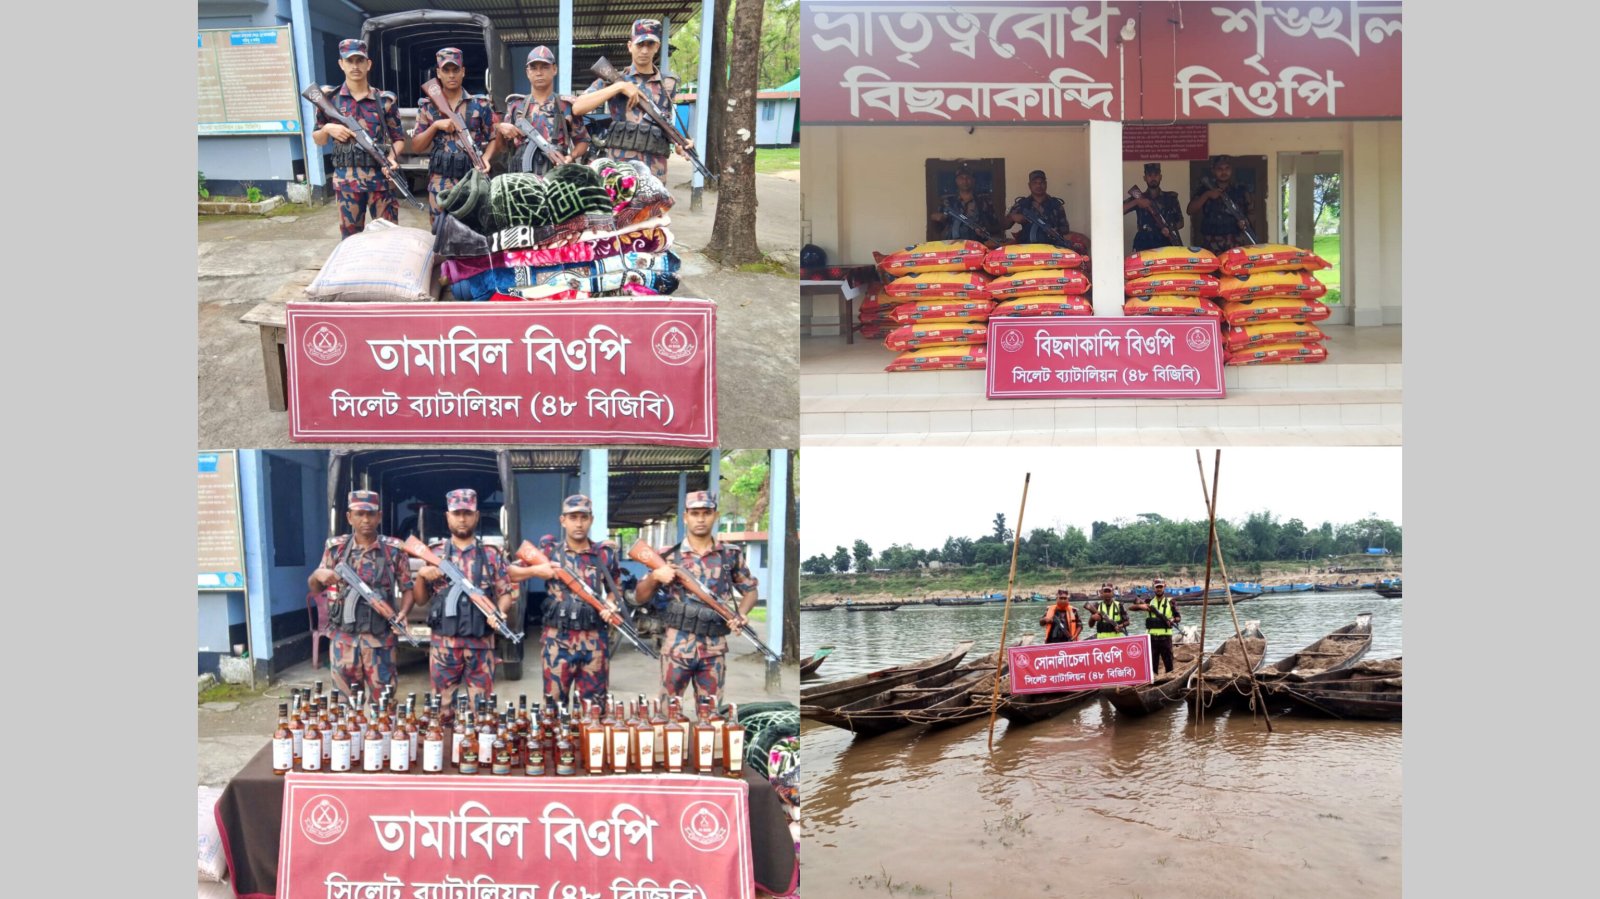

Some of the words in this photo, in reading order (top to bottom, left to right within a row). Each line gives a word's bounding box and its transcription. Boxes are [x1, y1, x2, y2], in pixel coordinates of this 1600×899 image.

[839, 65, 1113, 119] বিছনাকান্দি
[1174, 65, 1345, 116] বিওপি
[366, 325, 513, 376] তামাবিল
[520, 324, 632, 376] বিওপি
[1034, 329, 1121, 359] বিছনাকান্দি
[1125, 327, 1175, 357] বিওপি
[1012, 365, 1051, 384] সিলেট
[1055, 365, 1118, 383] ব্যাটালিয়ন
[1122, 367, 1148, 386] (৪৮
[1153, 364, 1201, 385] বিজিবি)
[329, 388, 402, 419] সিলেট
[407, 388, 522, 419] ব্যাটালিয়ন
[530, 391, 578, 423] (৪৮
[585, 388, 675, 426] বিজিবি)
[1033, 650, 1090, 671] সোনালীচেলা
[1092, 645, 1123, 666] বিওপি
[369, 800, 531, 861] তামাবিল
[538, 801, 660, 862] বিওপি
